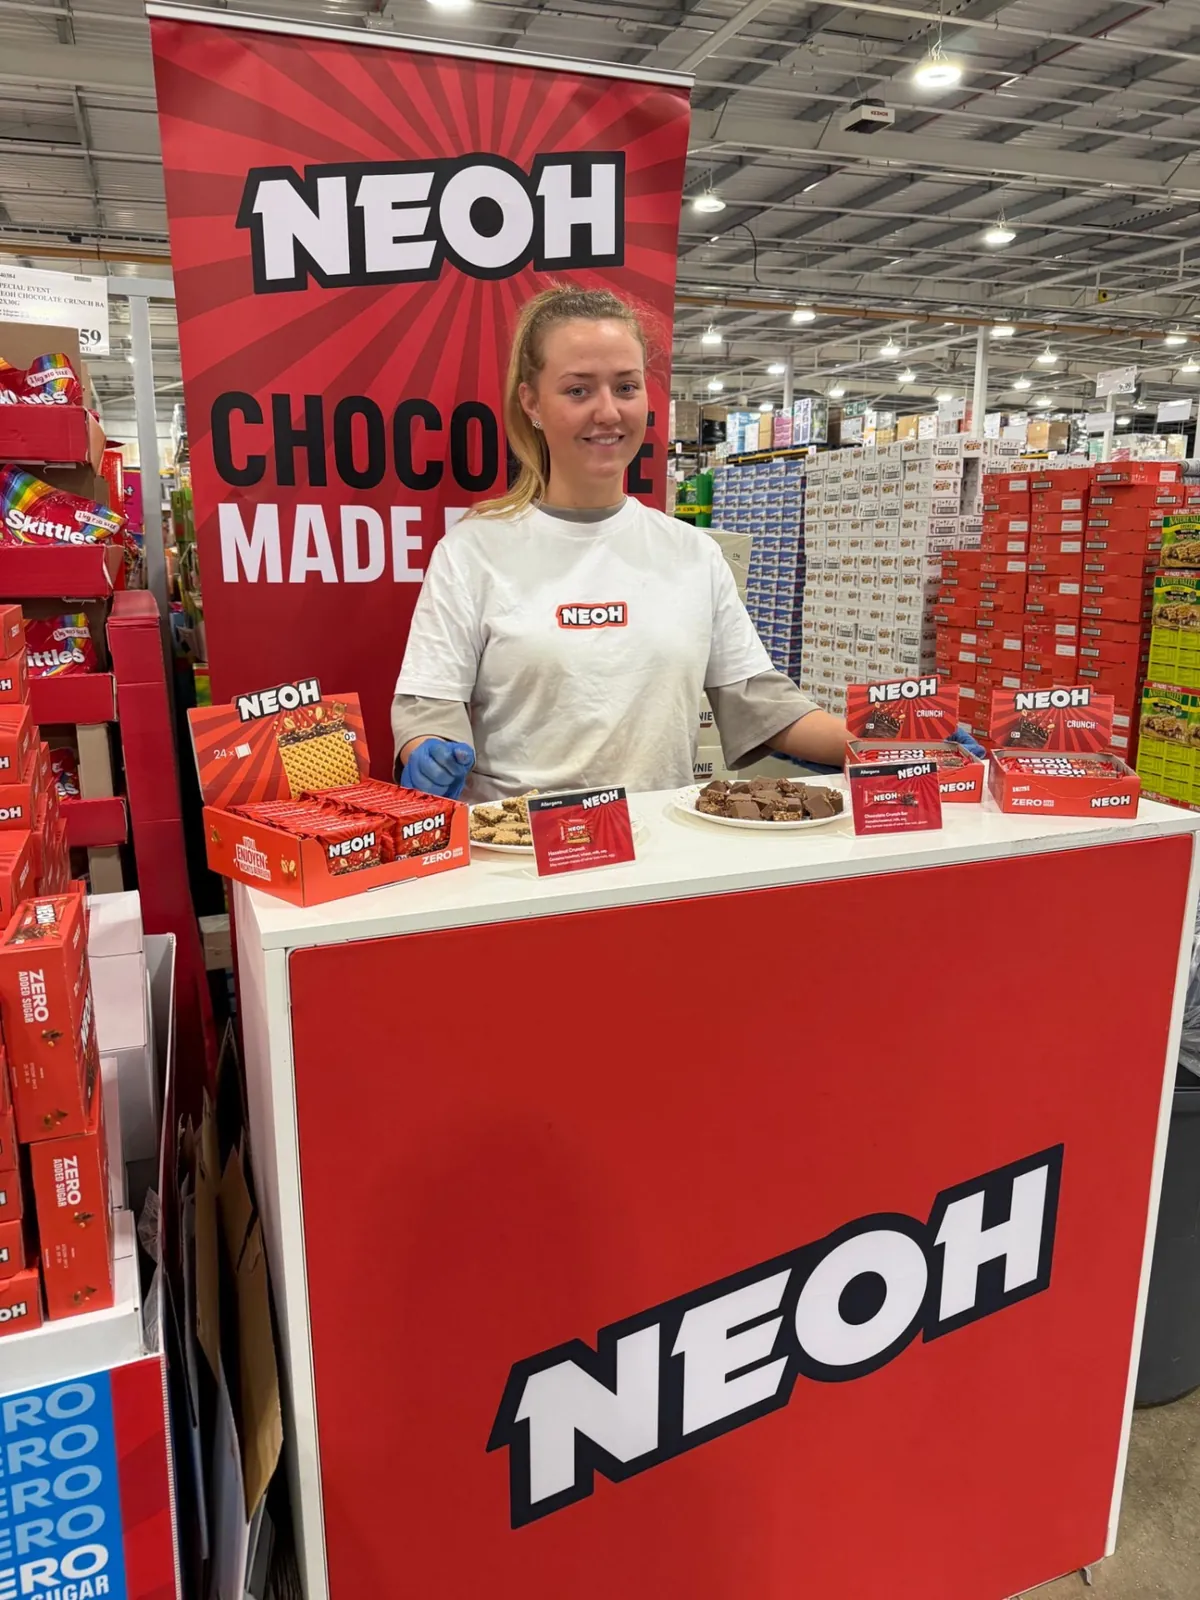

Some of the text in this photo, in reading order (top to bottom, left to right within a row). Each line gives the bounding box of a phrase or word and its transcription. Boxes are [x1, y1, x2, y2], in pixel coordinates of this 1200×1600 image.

[247, 159, 620, 287] NEOH
[0, 283, 51, 294] PECIAL EVENT
[0, 290, 16, 298] EOH
[18, 293, 62, 303] CHOCOLATE
[64, 298, 93, 307] CRUNCH
[210, 391, 655, 494] CHOCOE
[5, 508, 98, 545] Skittles
[218, 503, 423, 583] MADE
[561, 604, 624, 625] NEOH
[27, 647, 85, 667] ittles
[237, 679, 321, 722] NEOH
[869, 678, 937, 703] NEOH
[1015, 688, 1090, 711] NEOH
[916, 709, 943, 718] CRUNCH
[1066, 720, 1096, 729] CRUNCH
[213, 748, 227, 760] 24
[897, 763, 931, 780] NEOH
[873, 792, 898, 802] NEOH
[940, 781, 975, 793] NEOH
[540, 800, 563, 808] Allergens
[582, 789, 619, 810] NEOH
[1011, 798, 1042, 807] ZERO
[1091, 796, 1131, 807] NEOH
[0, 806, 22, 820] OH
[401, 813, 445, 840] NEOH
[328, 832, 376, 858] NEOH
[422, 850, 452, 866] ZERO
[18, 970, 34, 1024] ADDED SUGAR
[29, 968, 49, 1023] ZERO
[53, 1158, 68, 1208] ADDED SUGAR
[63, 1155, 82, 1206] ZERO
[0, 1302, 26, 1322] OH
[502, 1154, 1056, 1516] NEOH
[2, 1383, 96, 1433] RO
[0, 1543, 109, 1600] ERO
